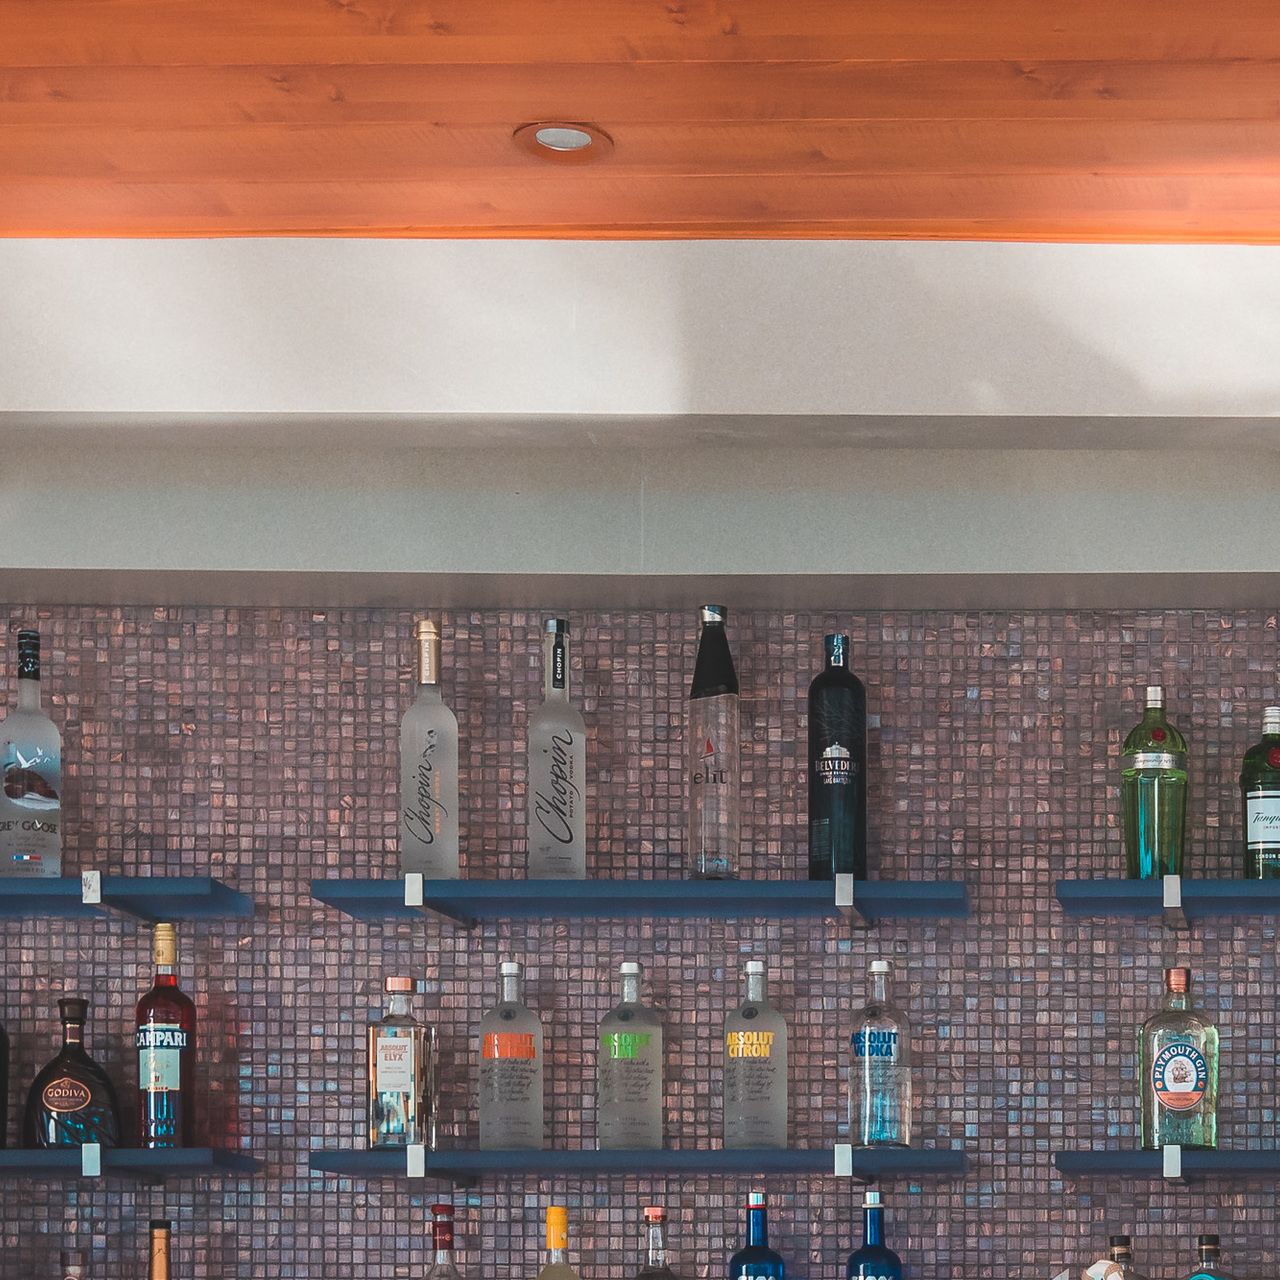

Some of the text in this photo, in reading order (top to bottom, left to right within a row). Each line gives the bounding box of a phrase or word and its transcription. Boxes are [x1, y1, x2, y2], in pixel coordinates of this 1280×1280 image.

[534, 728, 581, 844] Chopin
[403, 756, 448, 845] Chopin
[21, 821, 57, 834] GOOSE
[136, 1031, 187, 1047] CAMPARI
[726, 1031, 775, 1045] ABSOLUT
[384, 1052, 404, 1062] ELYX
[728, 1044, 771, 1058] CITRON
[853, 1044, 893, 1057] VODKA
[1154, 1045, 1206, 1079] PLYMOUTH GIN
[47, 1088, 86, 1098] GODIVA
